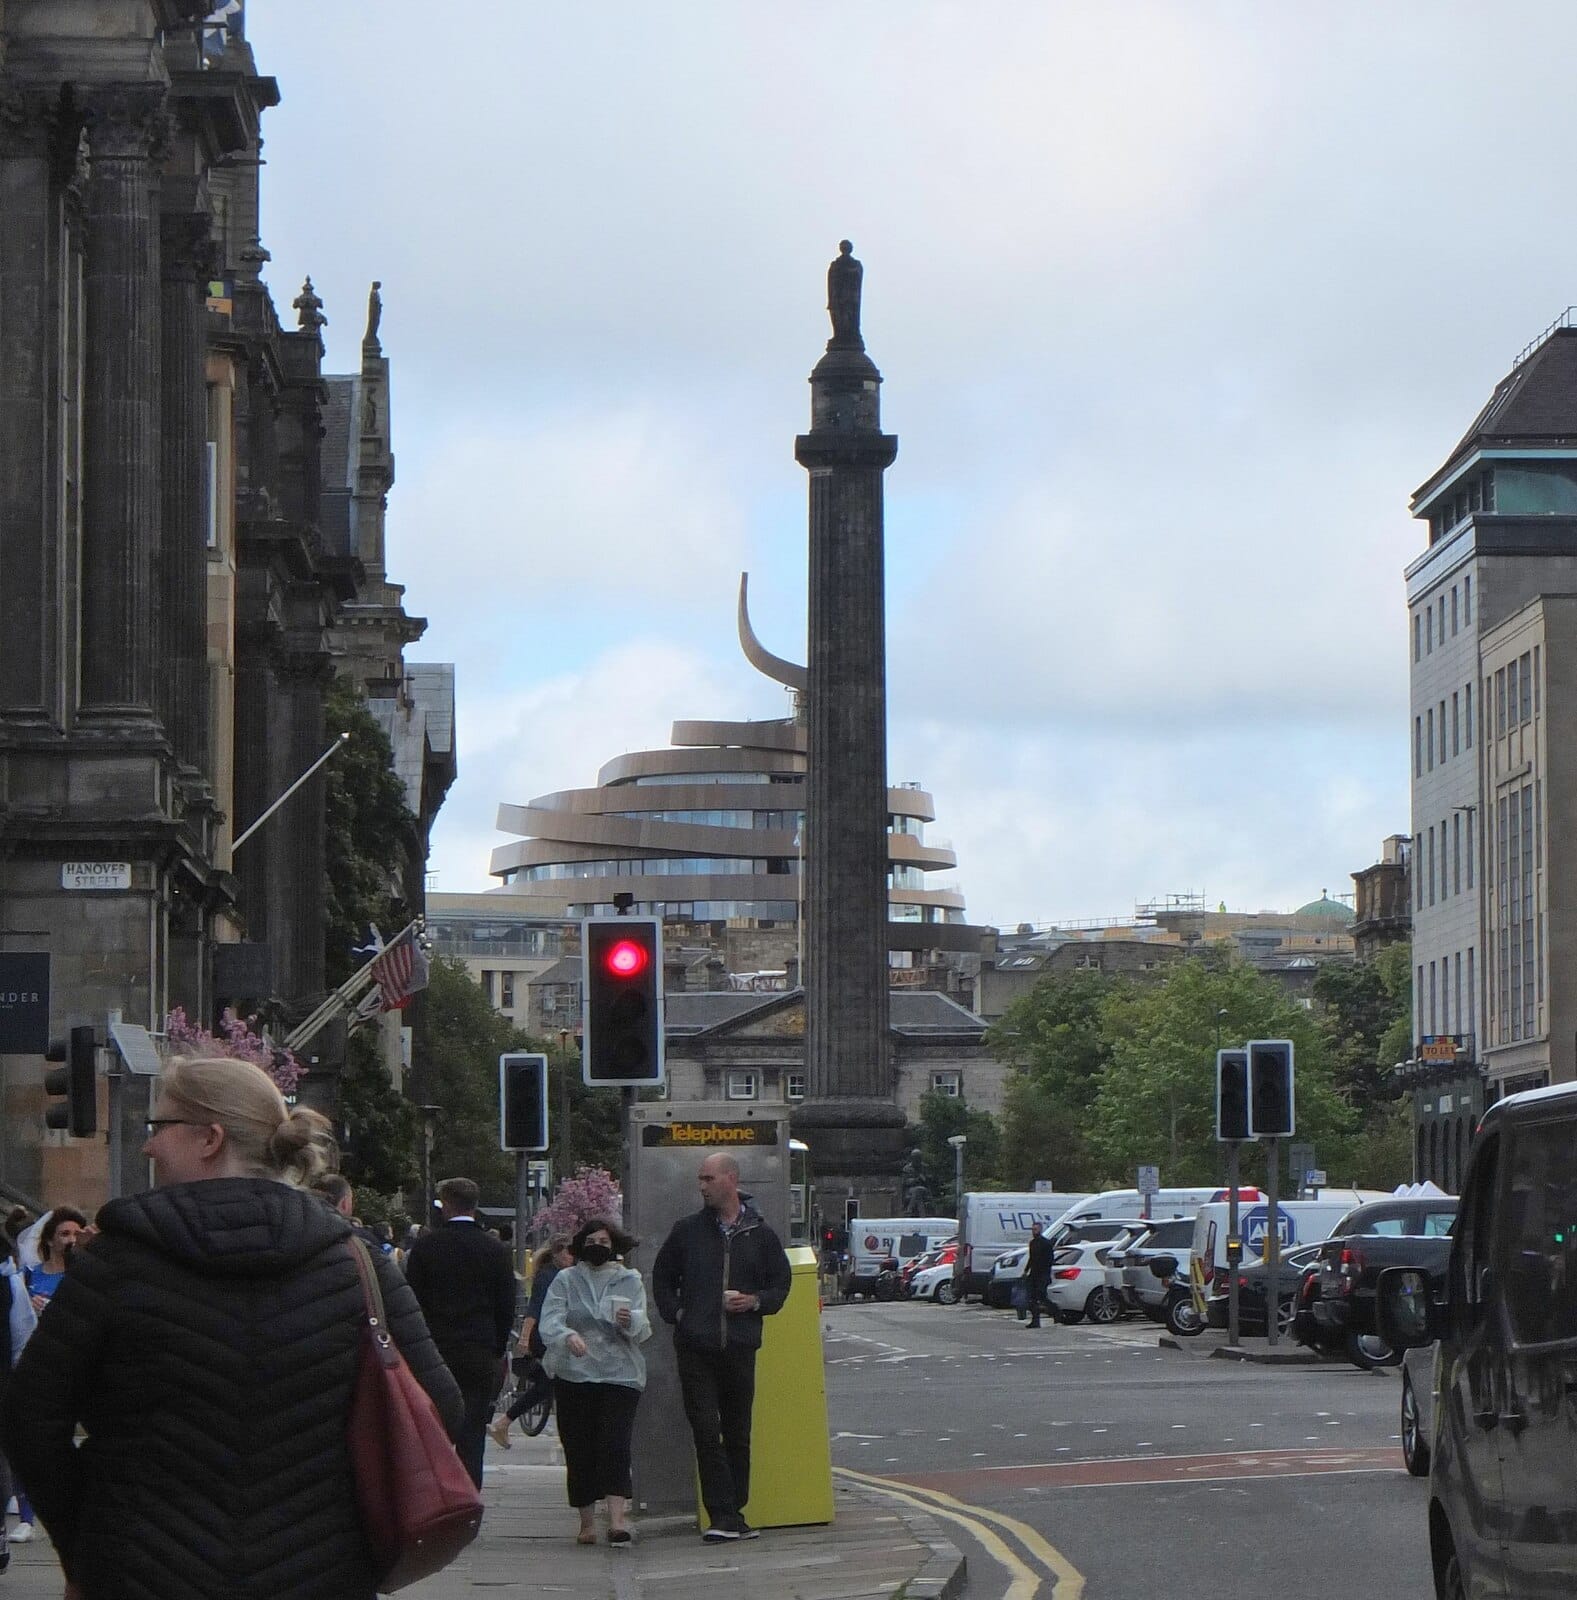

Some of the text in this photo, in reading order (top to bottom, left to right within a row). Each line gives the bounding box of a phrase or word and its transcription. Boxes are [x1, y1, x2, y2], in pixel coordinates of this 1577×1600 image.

[66, 863, 126, 875] HANOVER
[74, 876, 119, 887] STREET
[672, 1123, 754, 1144] Telephone
